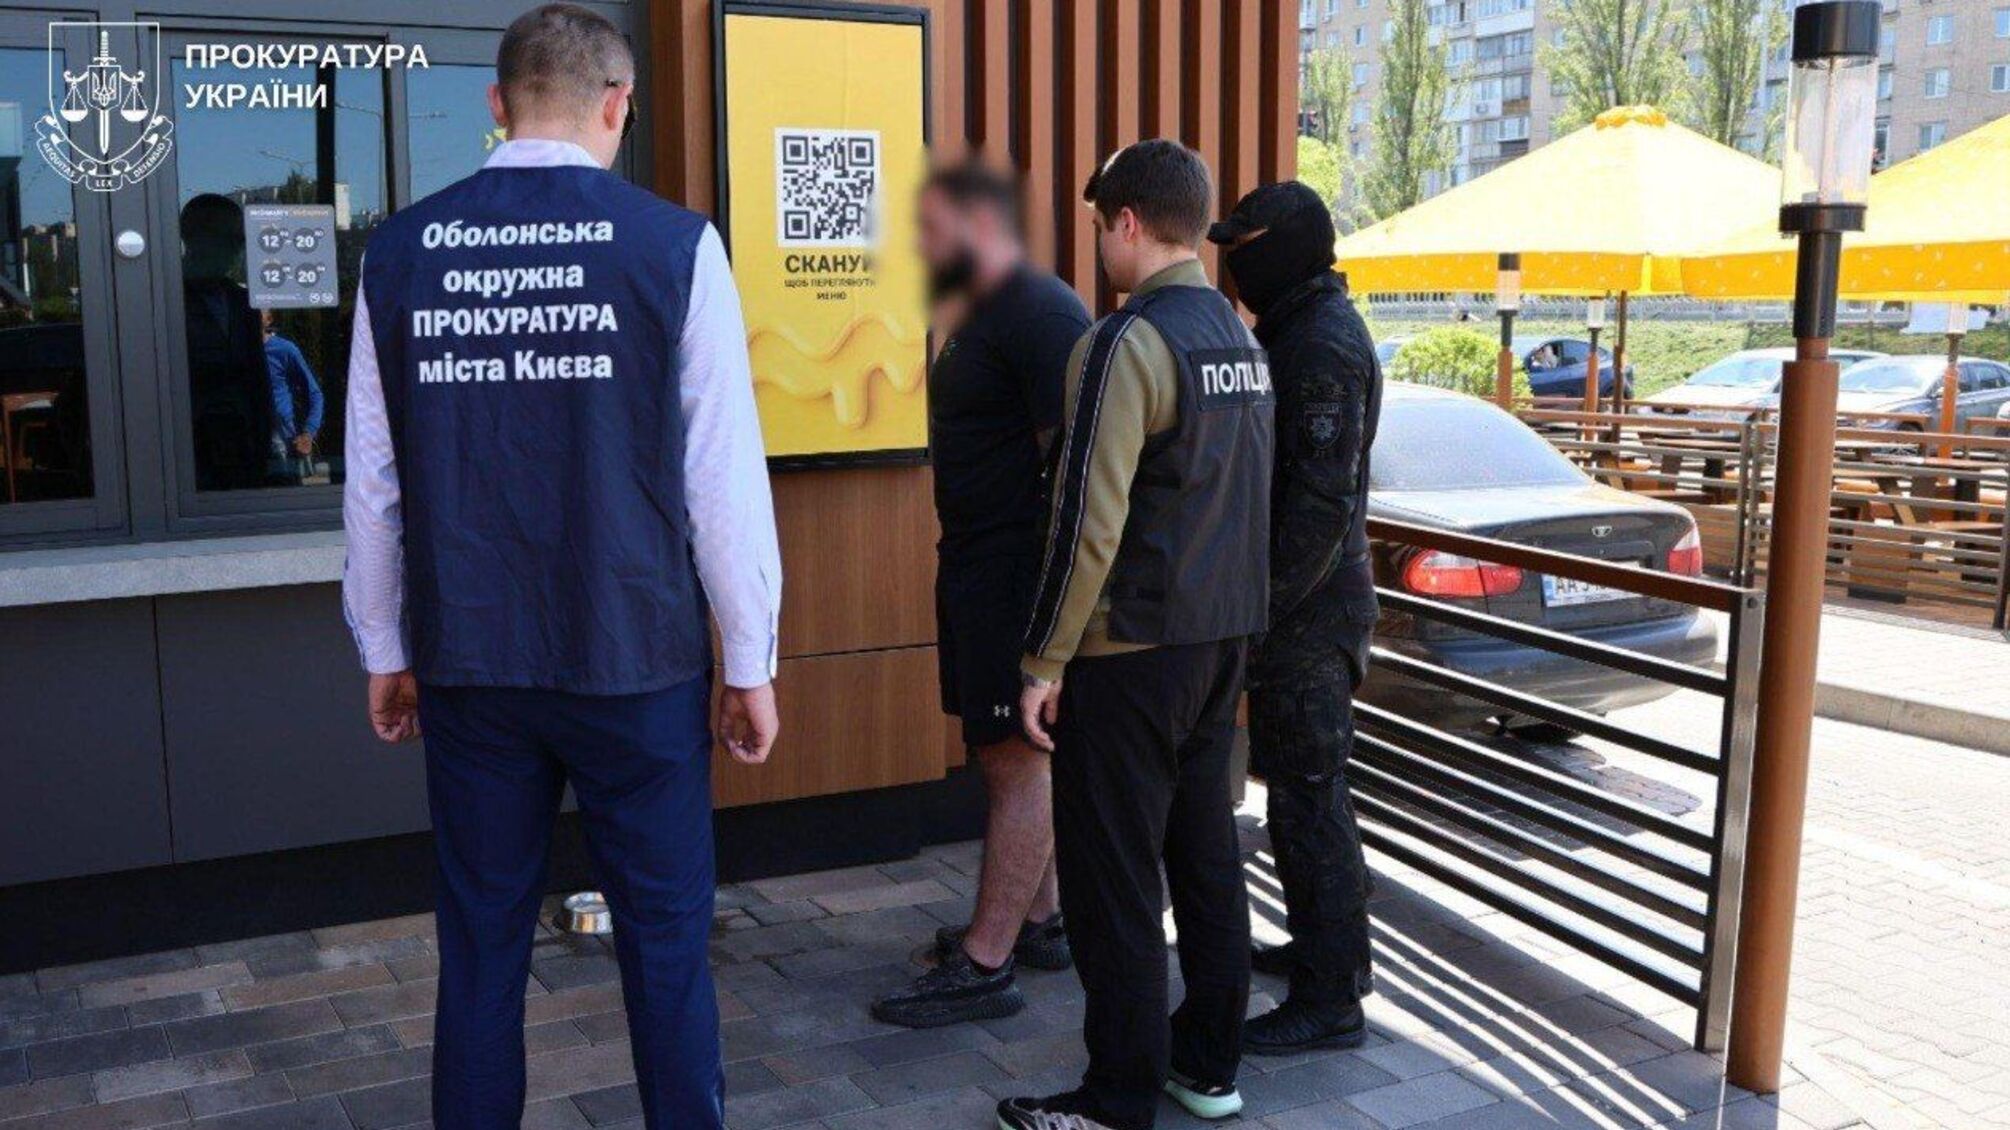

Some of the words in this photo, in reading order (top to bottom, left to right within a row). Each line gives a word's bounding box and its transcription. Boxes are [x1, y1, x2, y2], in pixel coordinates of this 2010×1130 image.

[262, 235, 280, 248] 12
[295, 235, 315, 248] 20
[422, 220, 614, 249] Оболонська
[263, 270, 280, 283] 12
[298, 270, 317, 283] 20
[443, 264, 584, 297] окружна
[413, 303, 618, 337] ПРОКУРАТУРА
[419, 352, 505, 383] міста
[515, 350, 613, 380] Києва
